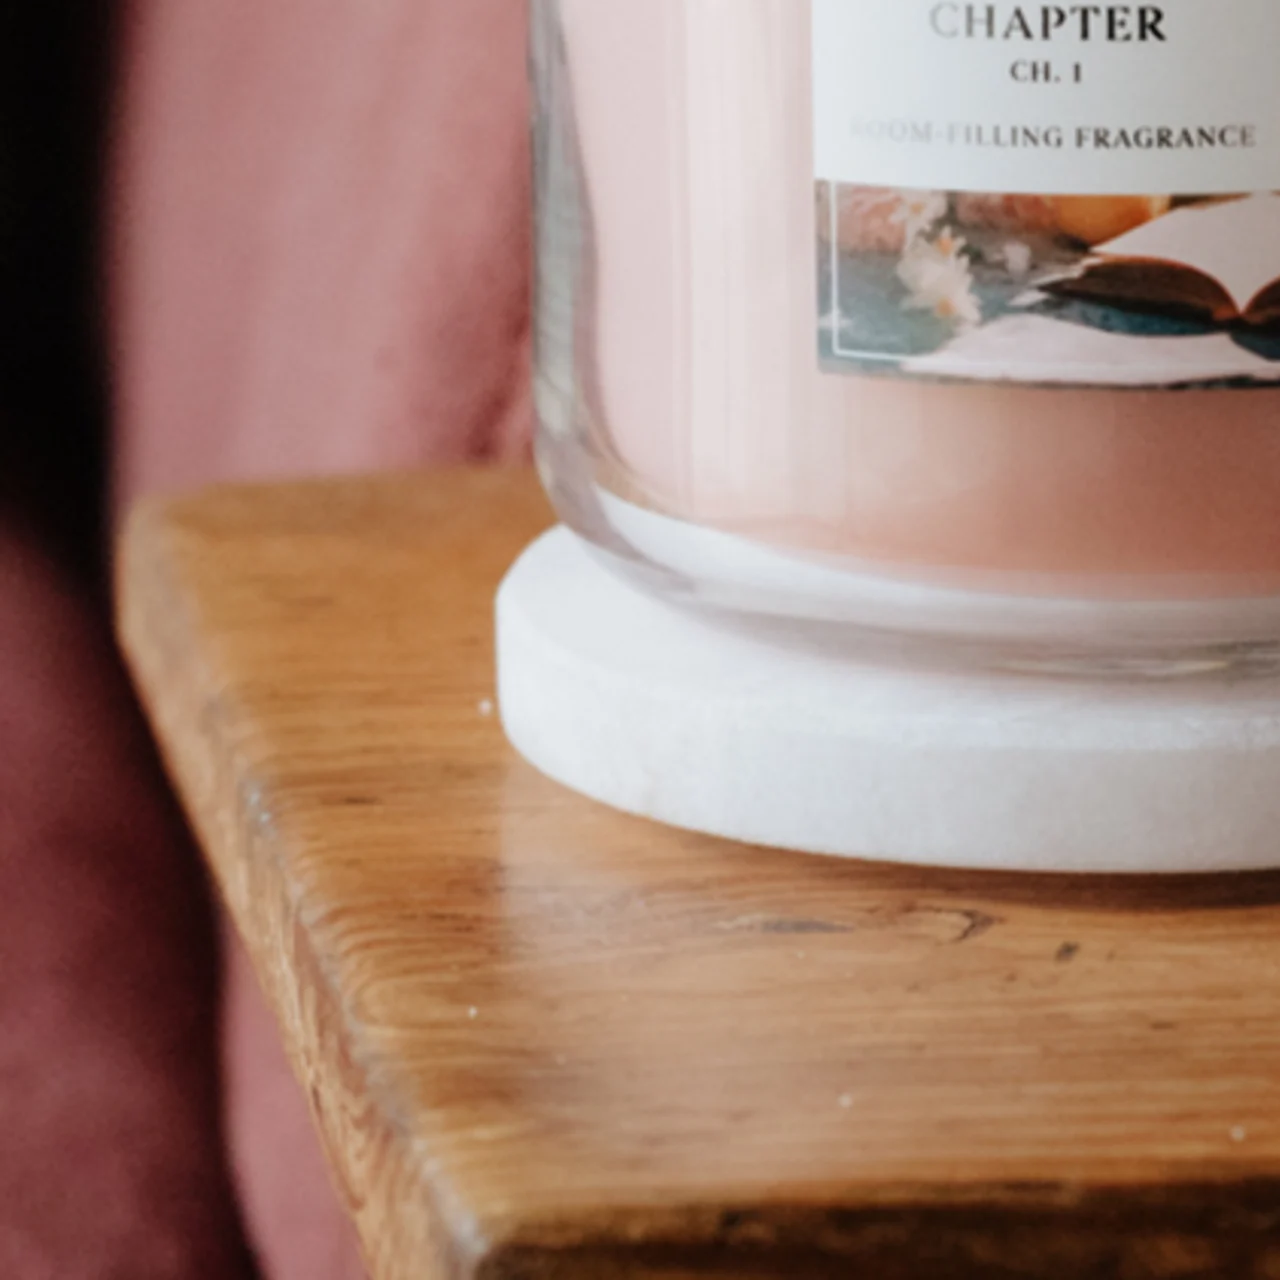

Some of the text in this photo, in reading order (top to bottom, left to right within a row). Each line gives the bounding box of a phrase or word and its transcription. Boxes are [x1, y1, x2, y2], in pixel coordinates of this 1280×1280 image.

[928, 1, 1168, 44] CHAPTER
[1009, 60, 1062, 84] CH.
[1074, 125, 1258, 150] FRAGRANCE
